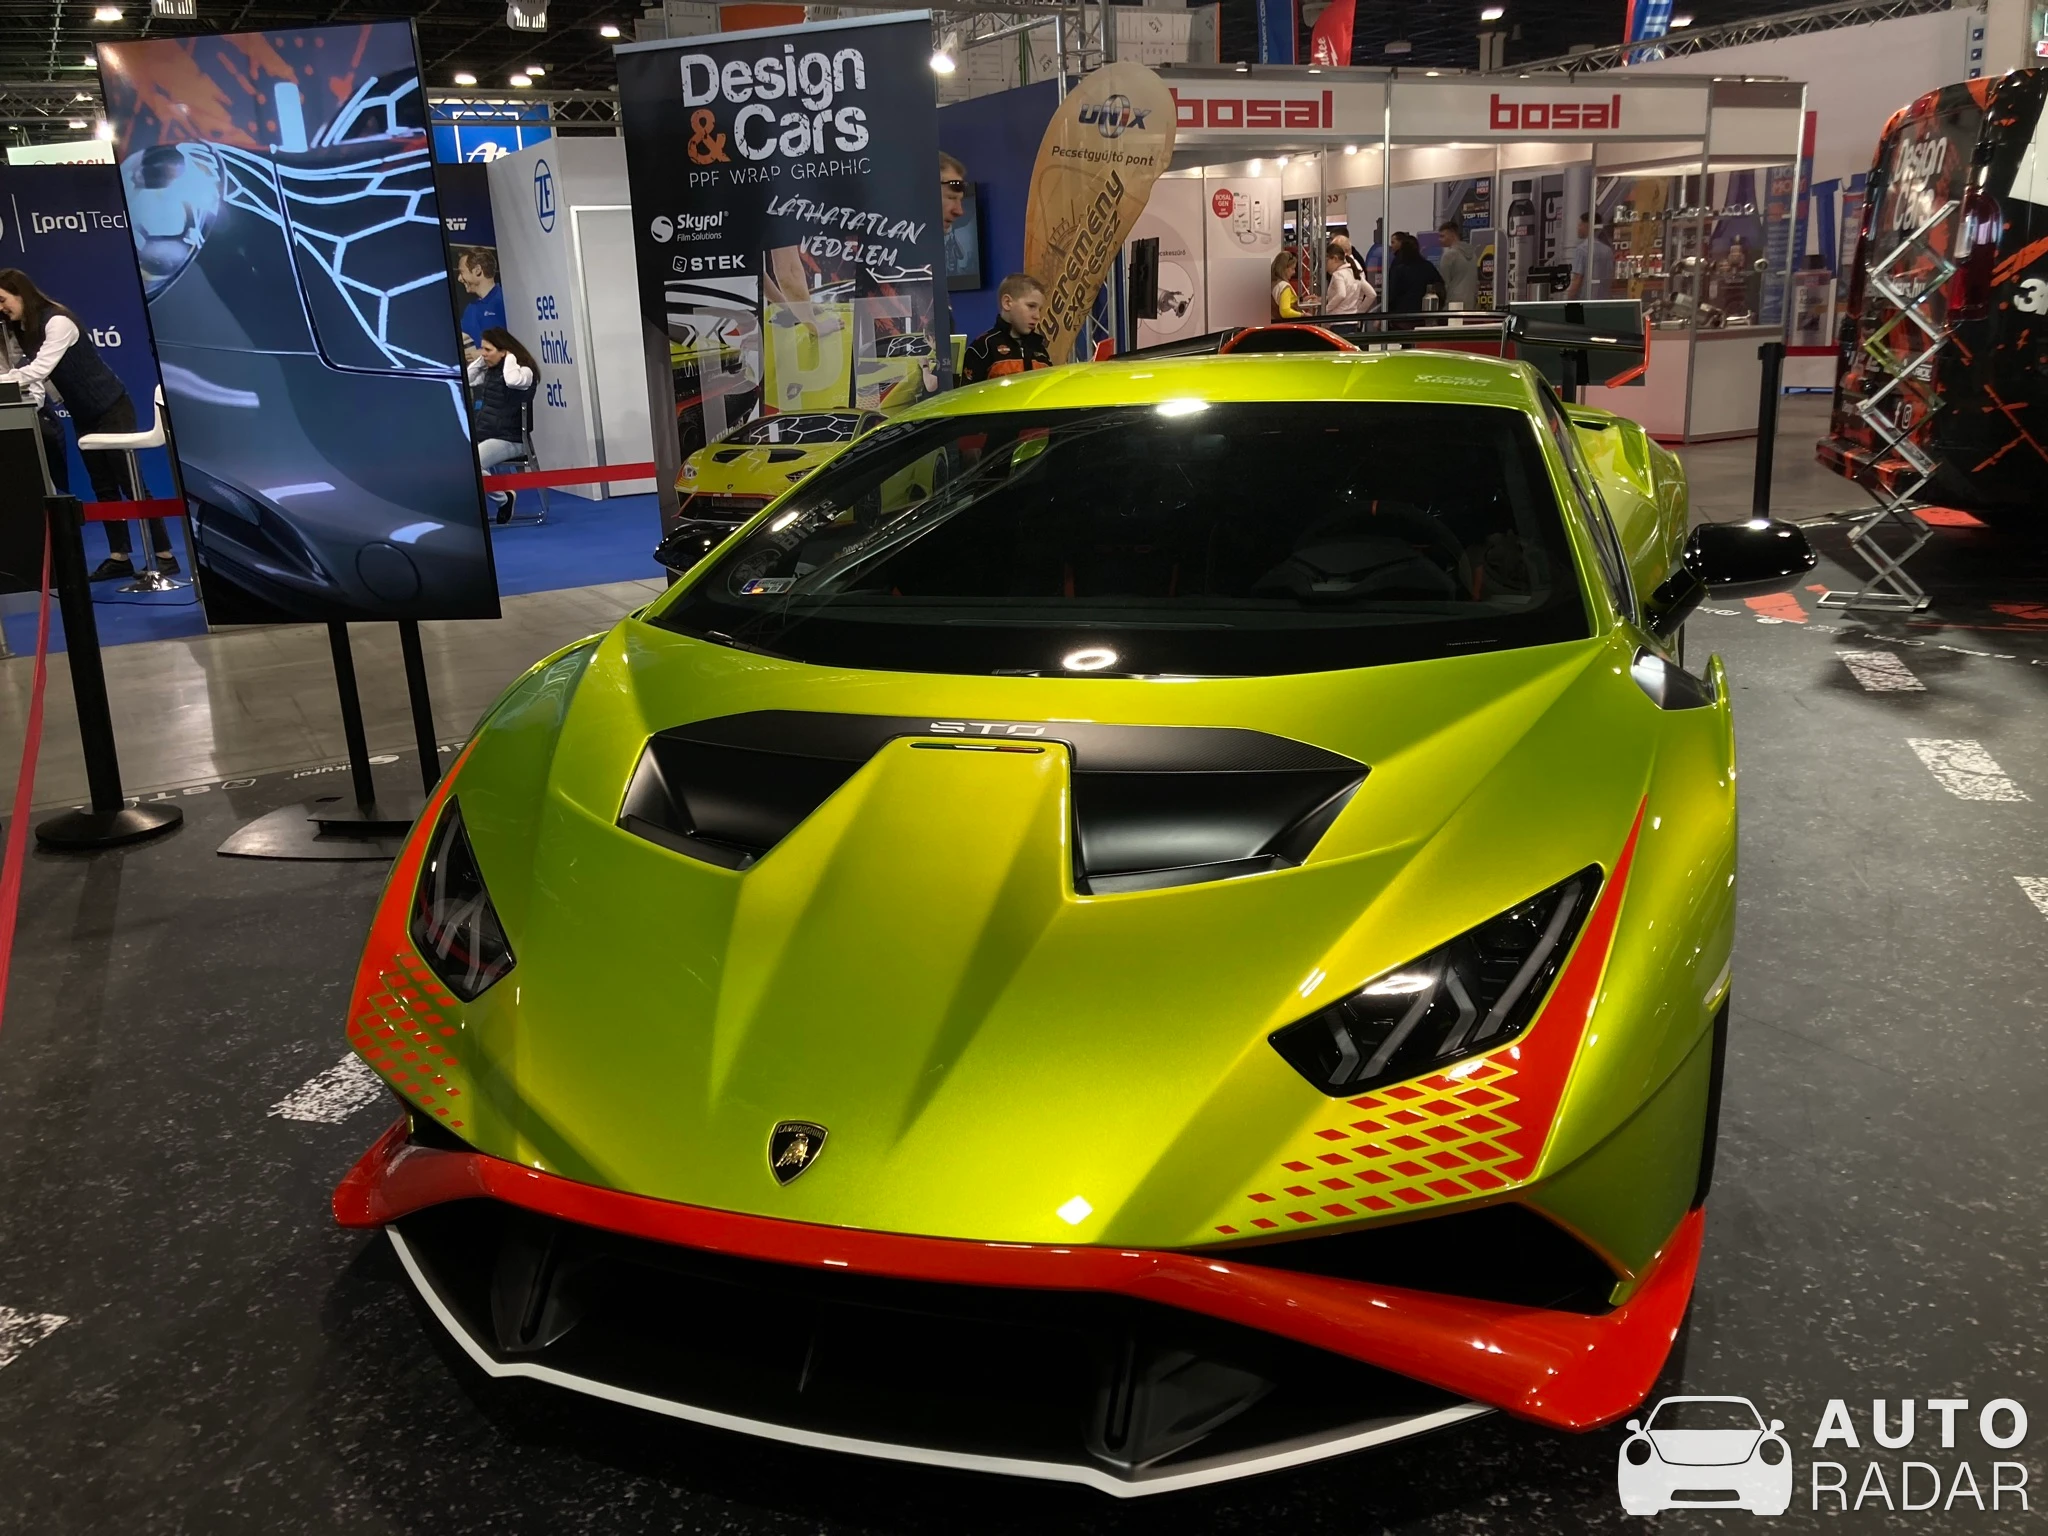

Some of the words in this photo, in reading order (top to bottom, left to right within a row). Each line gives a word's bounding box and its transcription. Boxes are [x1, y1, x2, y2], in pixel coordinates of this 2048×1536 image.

[680, 44, 866, 111] Design
[1168, 88, 1333, 128] bosal
[1490, 94, 1621, 129] bosal
[687, 108, 732, 165] &
[734, 103, 869, 160] Cars
[689, 171, 720, 188] PPF
[729, 165, 781, 185] WRAP
[790, 157, 871, 180] GRAPHIC
[1126, 155, 1154, 166] pont
[446, 218, 467, 231] RW
[766, 193, 926, 244] LÁTHATATLAN
[677, 234, 691, 242] Film
[692, 232, 722, 241] Solutions
[800, 231, 898, 267] VÉDELEM
[690, 254, 746, 271] STEK
[536, 295, 558, 320] see.
[87, 325, 122, 347] tó
[540, 331, 573, 365] think.
[547, 378, 567, 408] act.
[929, 721, 1046, 737] STO
[778, 1125, 824, 1139] LAMBORGHINI
